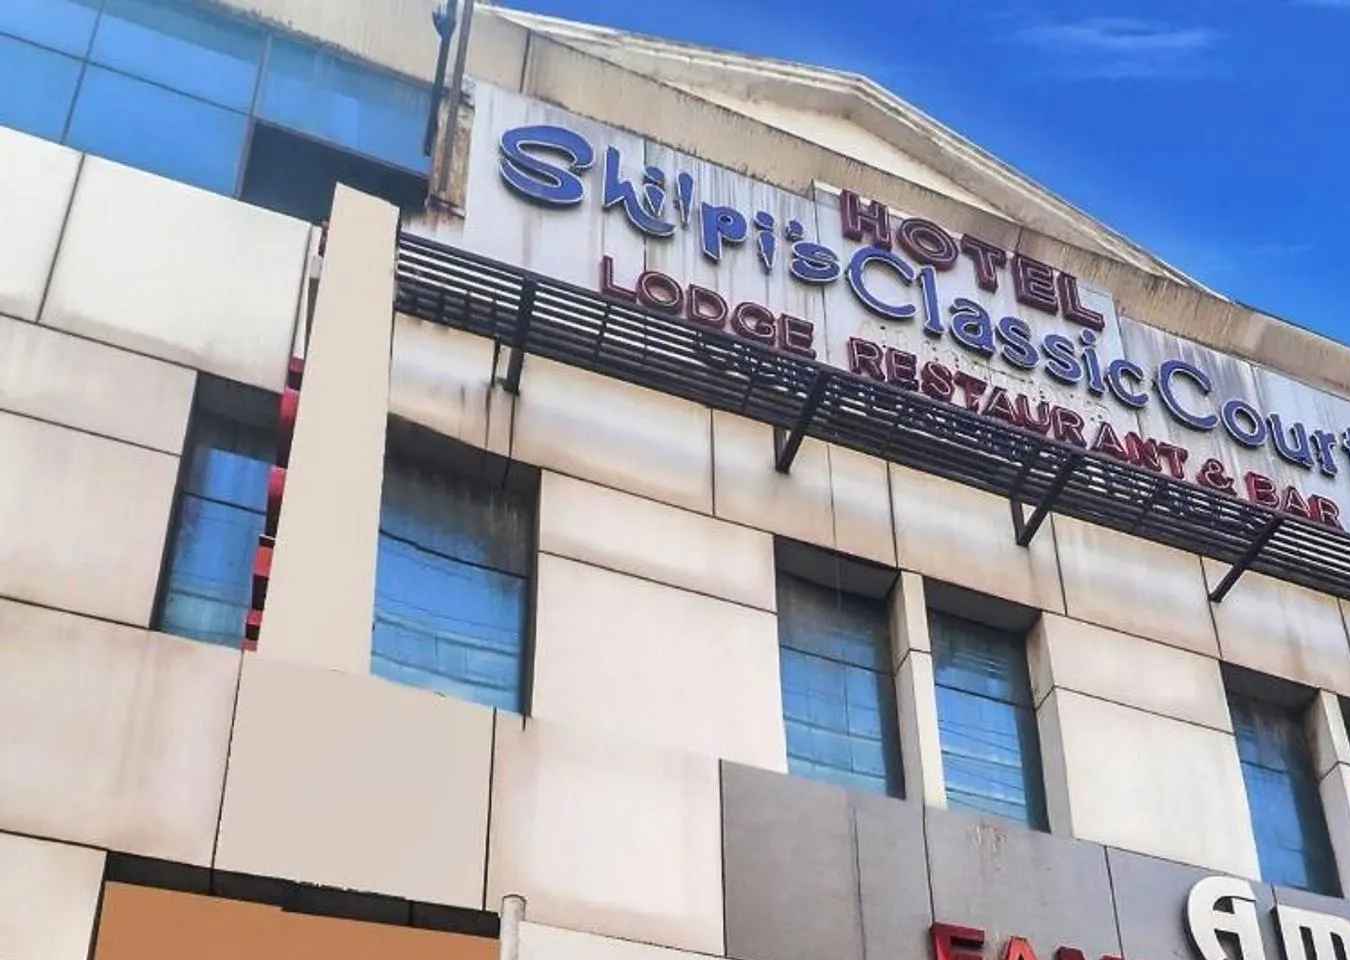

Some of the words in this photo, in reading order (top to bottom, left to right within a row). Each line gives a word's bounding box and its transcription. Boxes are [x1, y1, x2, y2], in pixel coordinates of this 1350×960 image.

[840, 188, 1105, 331] HOTEL
[847, 245, 1149, 407] Classic
[600, 254, 816, 360] LODGE
[848, 336, 1188, 481] RESTAURANT
[1197, 458, 1238, 496] &
[1245, 471, 1346, 532] BAR
